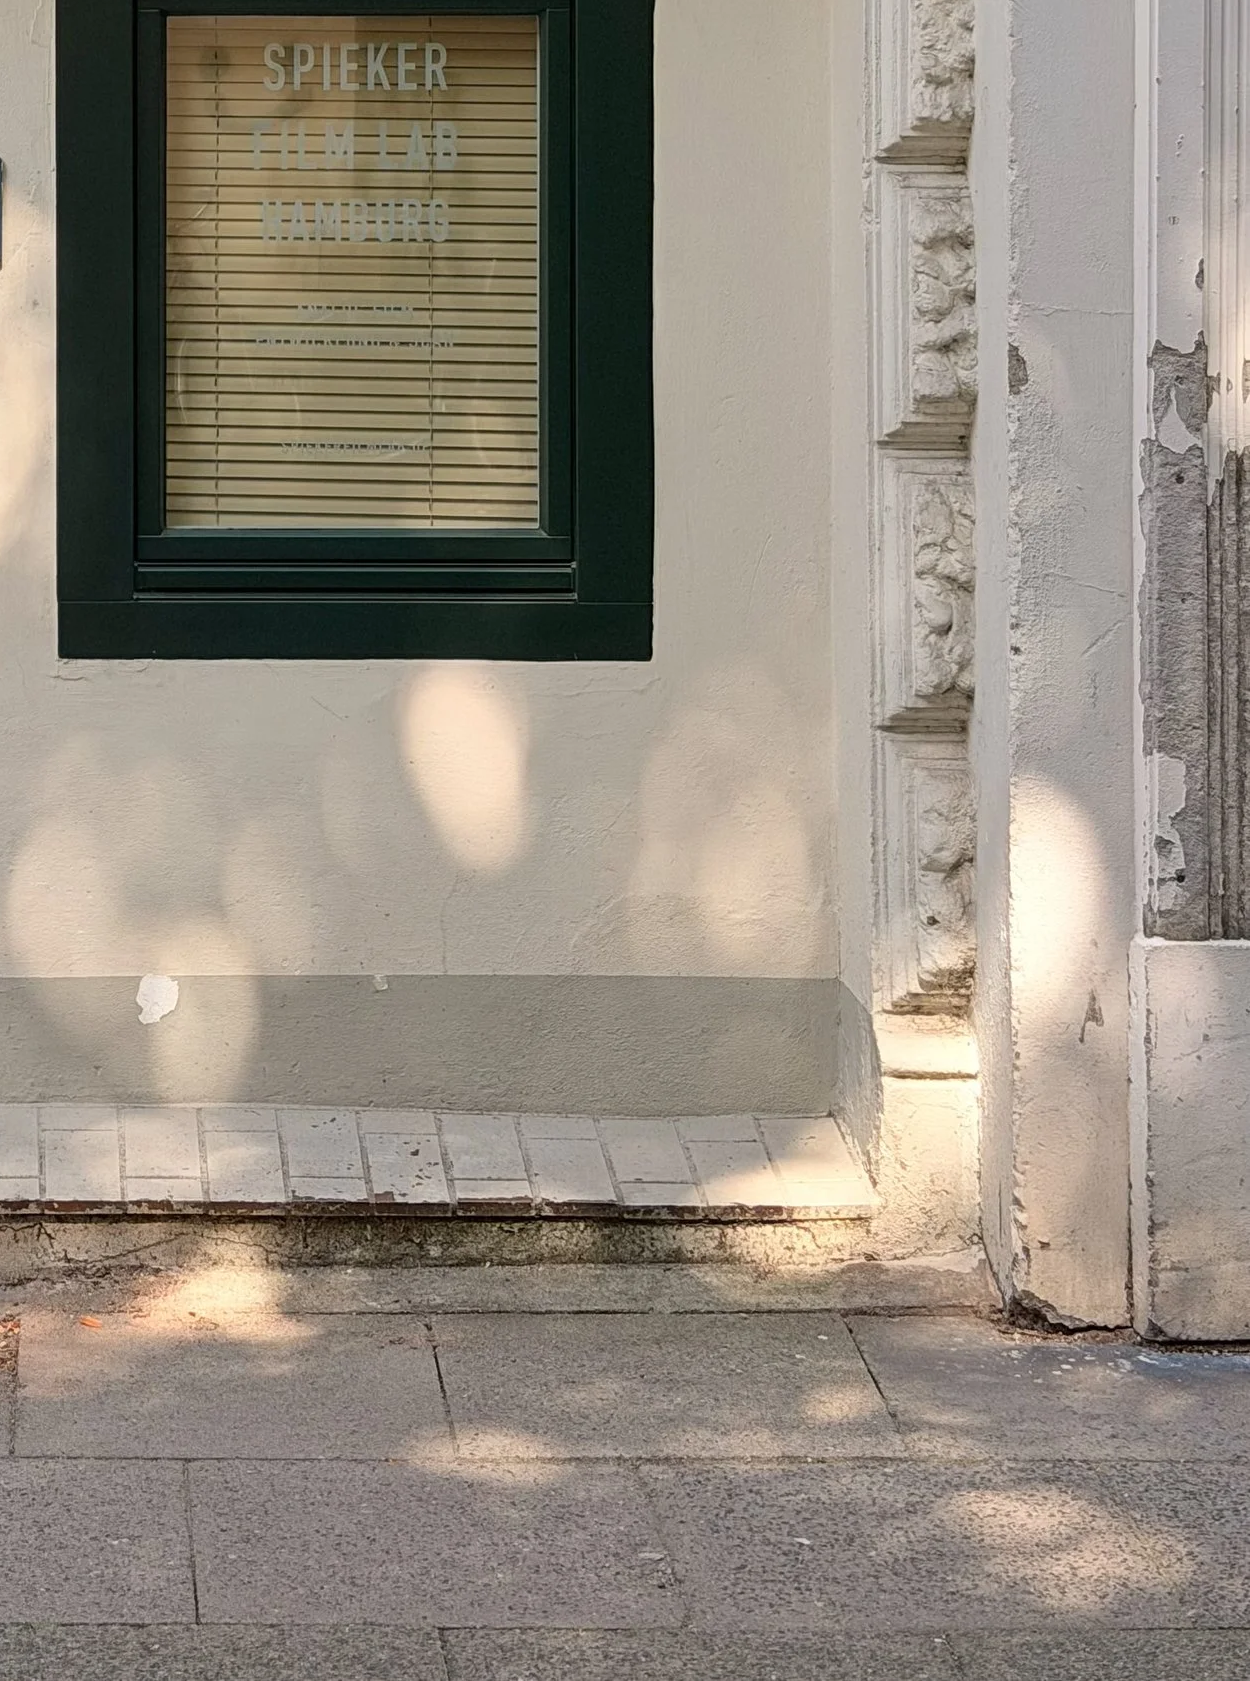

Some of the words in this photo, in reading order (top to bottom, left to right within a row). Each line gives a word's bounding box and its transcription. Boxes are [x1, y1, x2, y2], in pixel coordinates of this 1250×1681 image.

[262, 41, 449, 92] SPIEKER
[249, 122, 355, 171] FILM
[378, 122, 460, 171] LAB
[261, 199, 451, 244] HAMBURG
